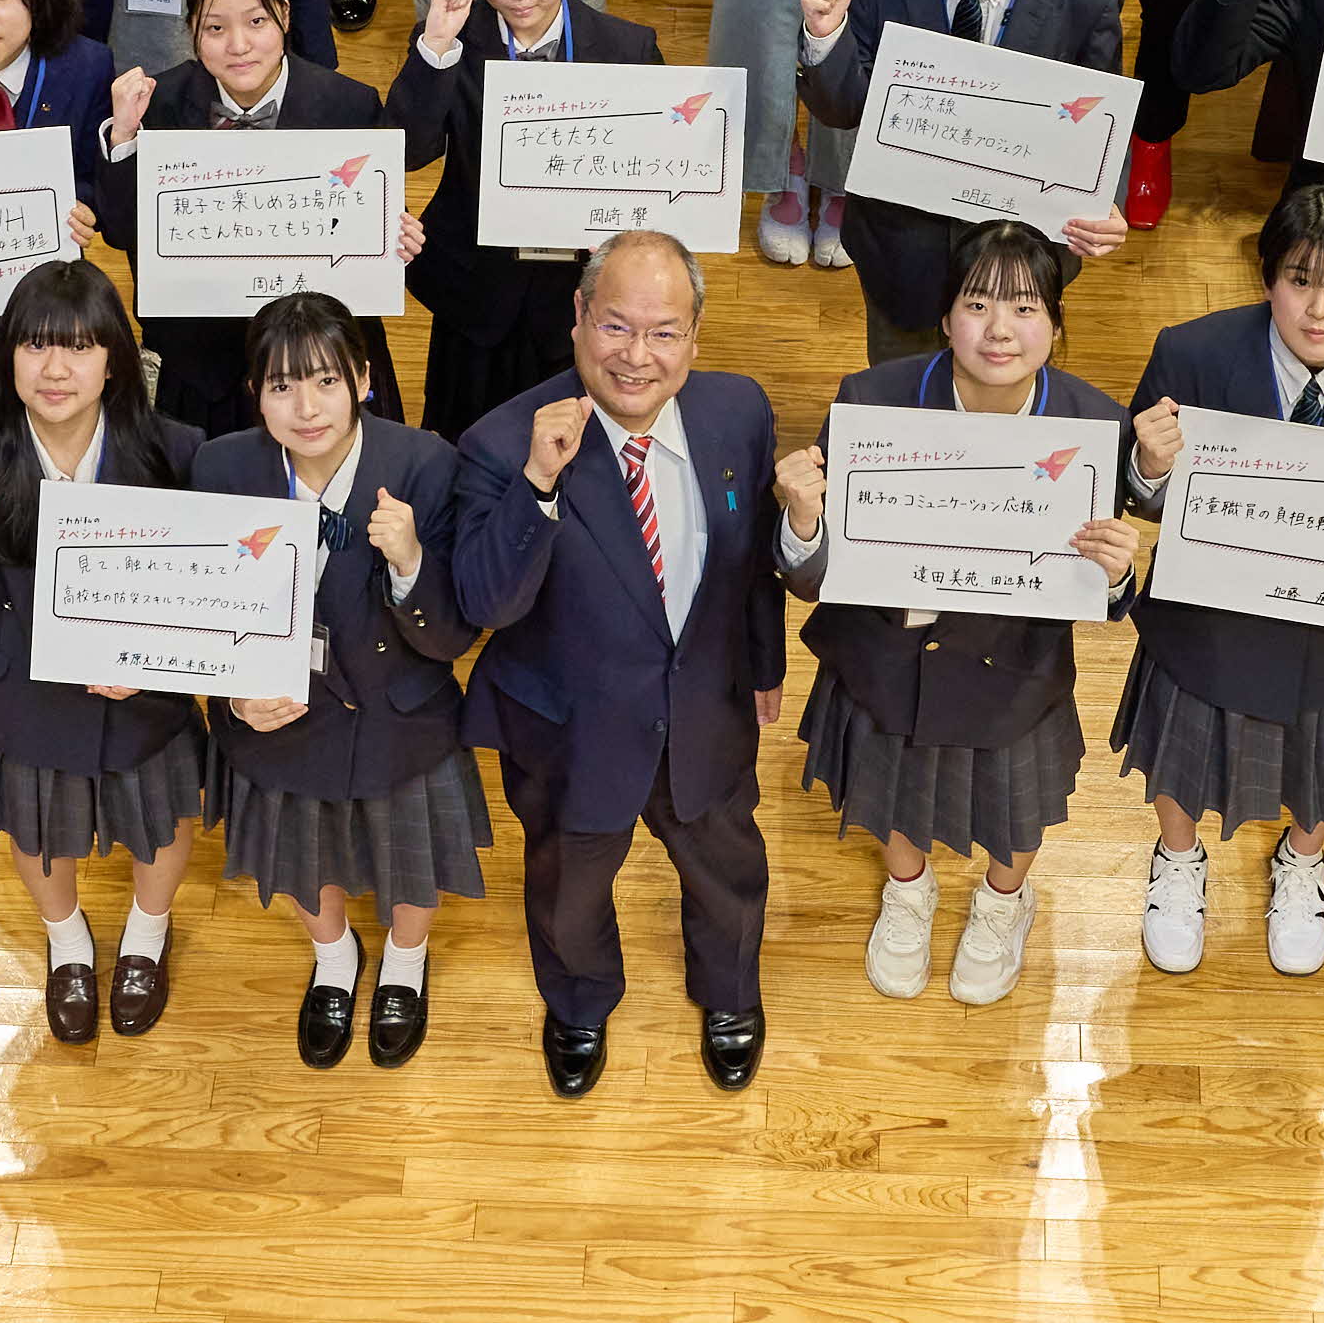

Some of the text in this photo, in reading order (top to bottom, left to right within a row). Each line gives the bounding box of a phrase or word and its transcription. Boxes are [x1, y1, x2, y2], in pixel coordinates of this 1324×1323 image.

[892, 68, 1001, 92] スペシャルチャレンジ
[502, 99, 611, 117] スペシャルチャレンジ
[896, 88, 959, 117] 木次線
[516, 127, 615, 147] 子どもたちと
[887, 112, 1033, 159] 乗り降り改善プロジェクト
[157, 164, 267, 186] スペシャルチャレンジ
[172, 189, 366, 216] 親子で楽しめる場所を
[168, 218, 340, 242] たくさん知ってもらう!
[848, 449, 967, 466] スペシャルチャレンジ
[1192, 454, 1310, 473] スペシャルチャレンジ
[856, 489, 1051, 517] 親子のコミュニケーション応援!!
[57, 527, 173, 541] スペシャルチャレンジ
[63, 584, 270, 614] 高校生の防災スキルアッププロジェクト
